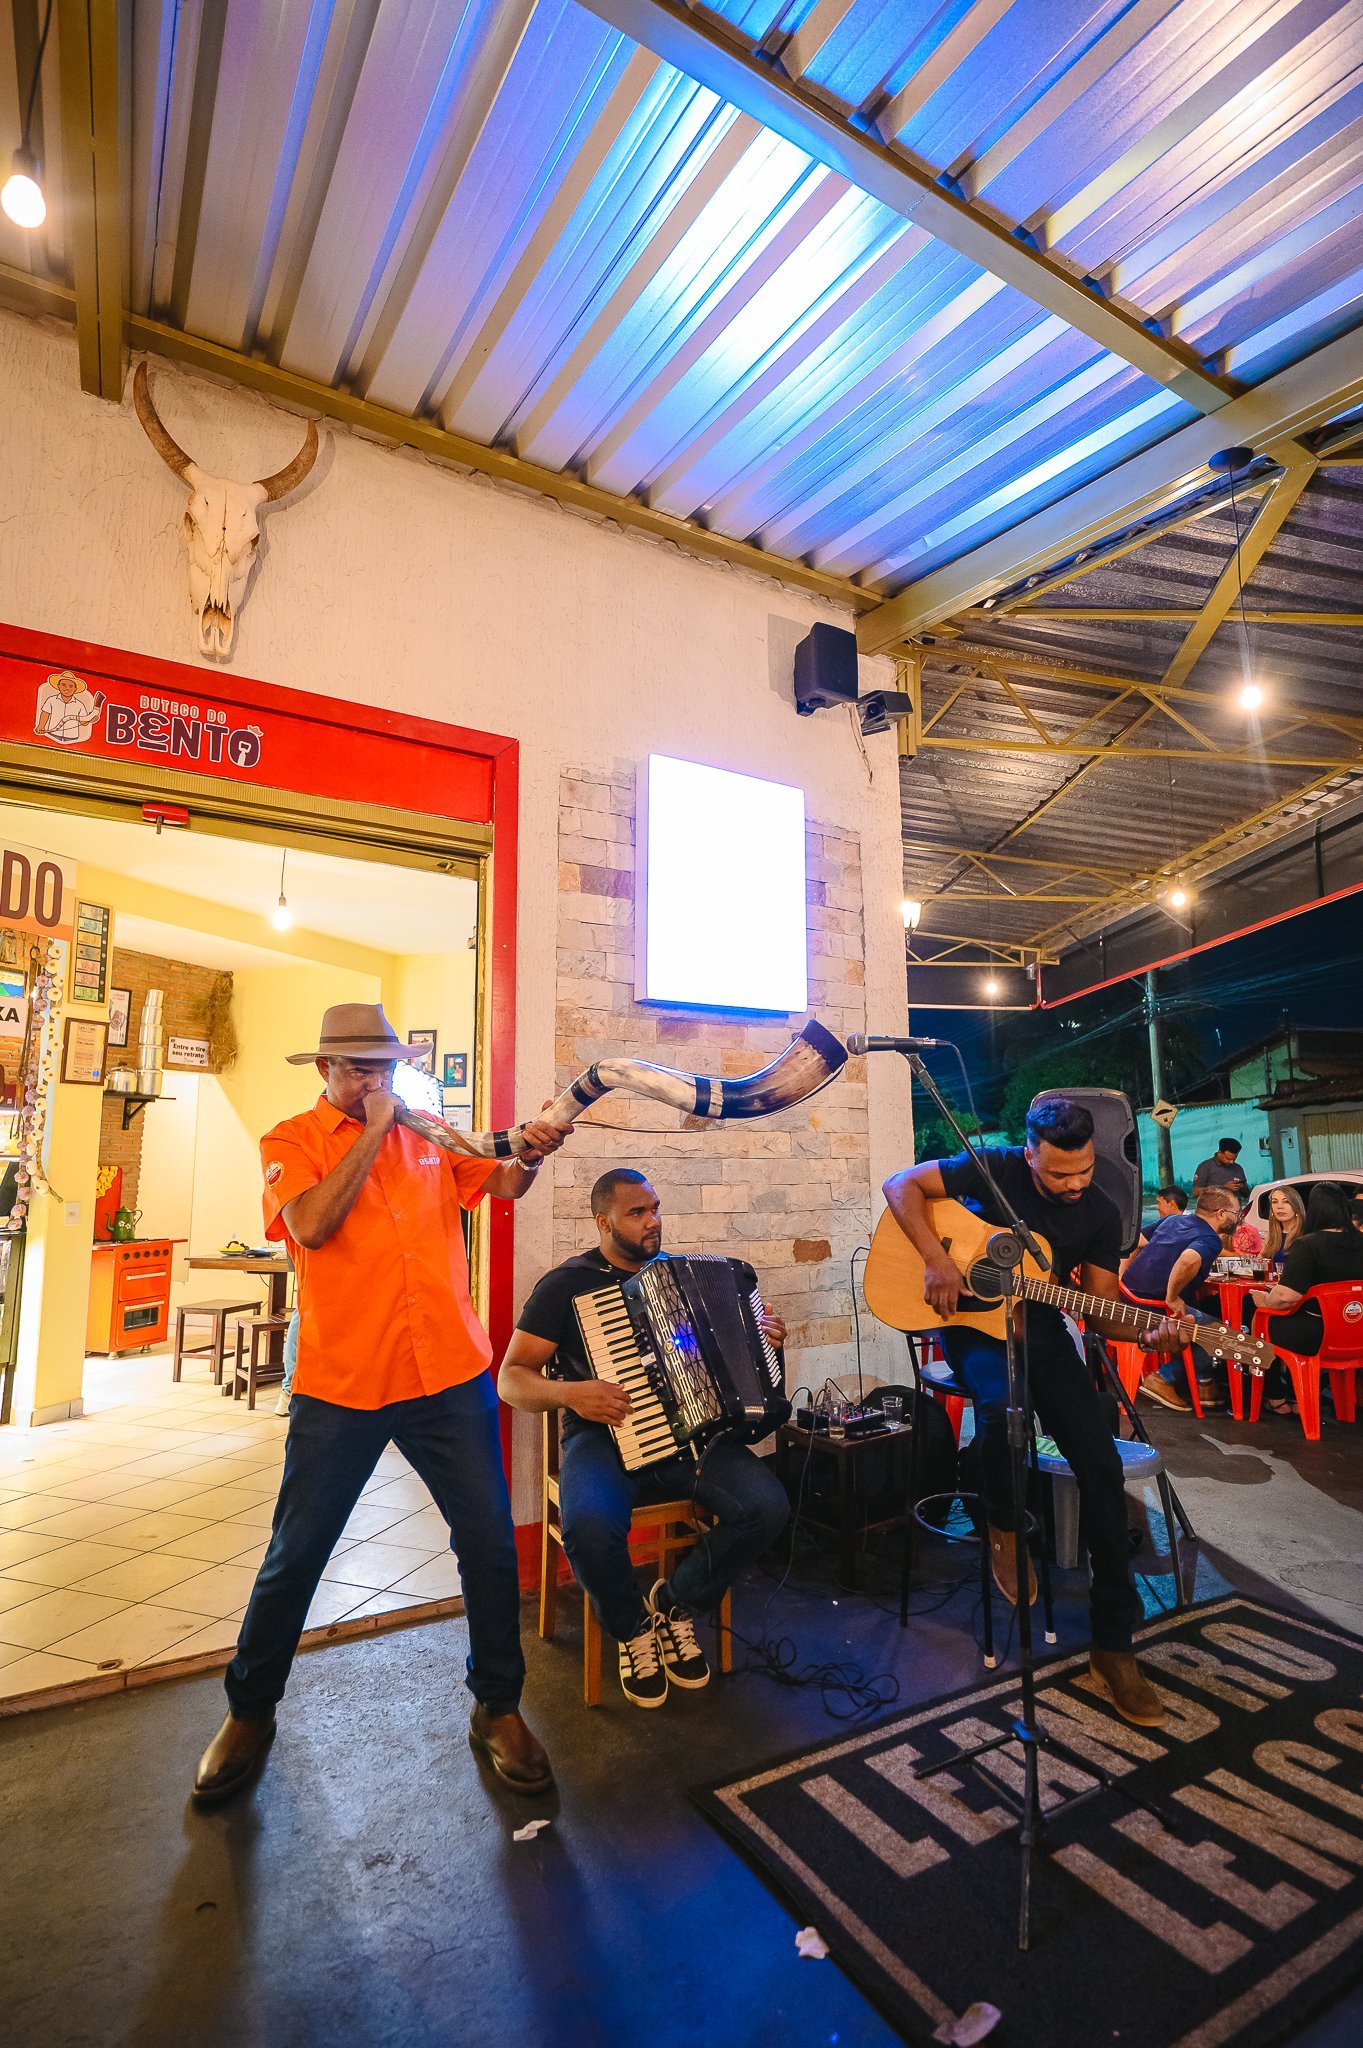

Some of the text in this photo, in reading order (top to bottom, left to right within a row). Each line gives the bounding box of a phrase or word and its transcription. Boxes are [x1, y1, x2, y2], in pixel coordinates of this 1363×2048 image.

[140, 695, 227, 725] BUTECO DO
[106, 704, 261, 768] BENTO
[0, 849, 64, 928] DO
[173, 1043, 189, 1051] Entre
